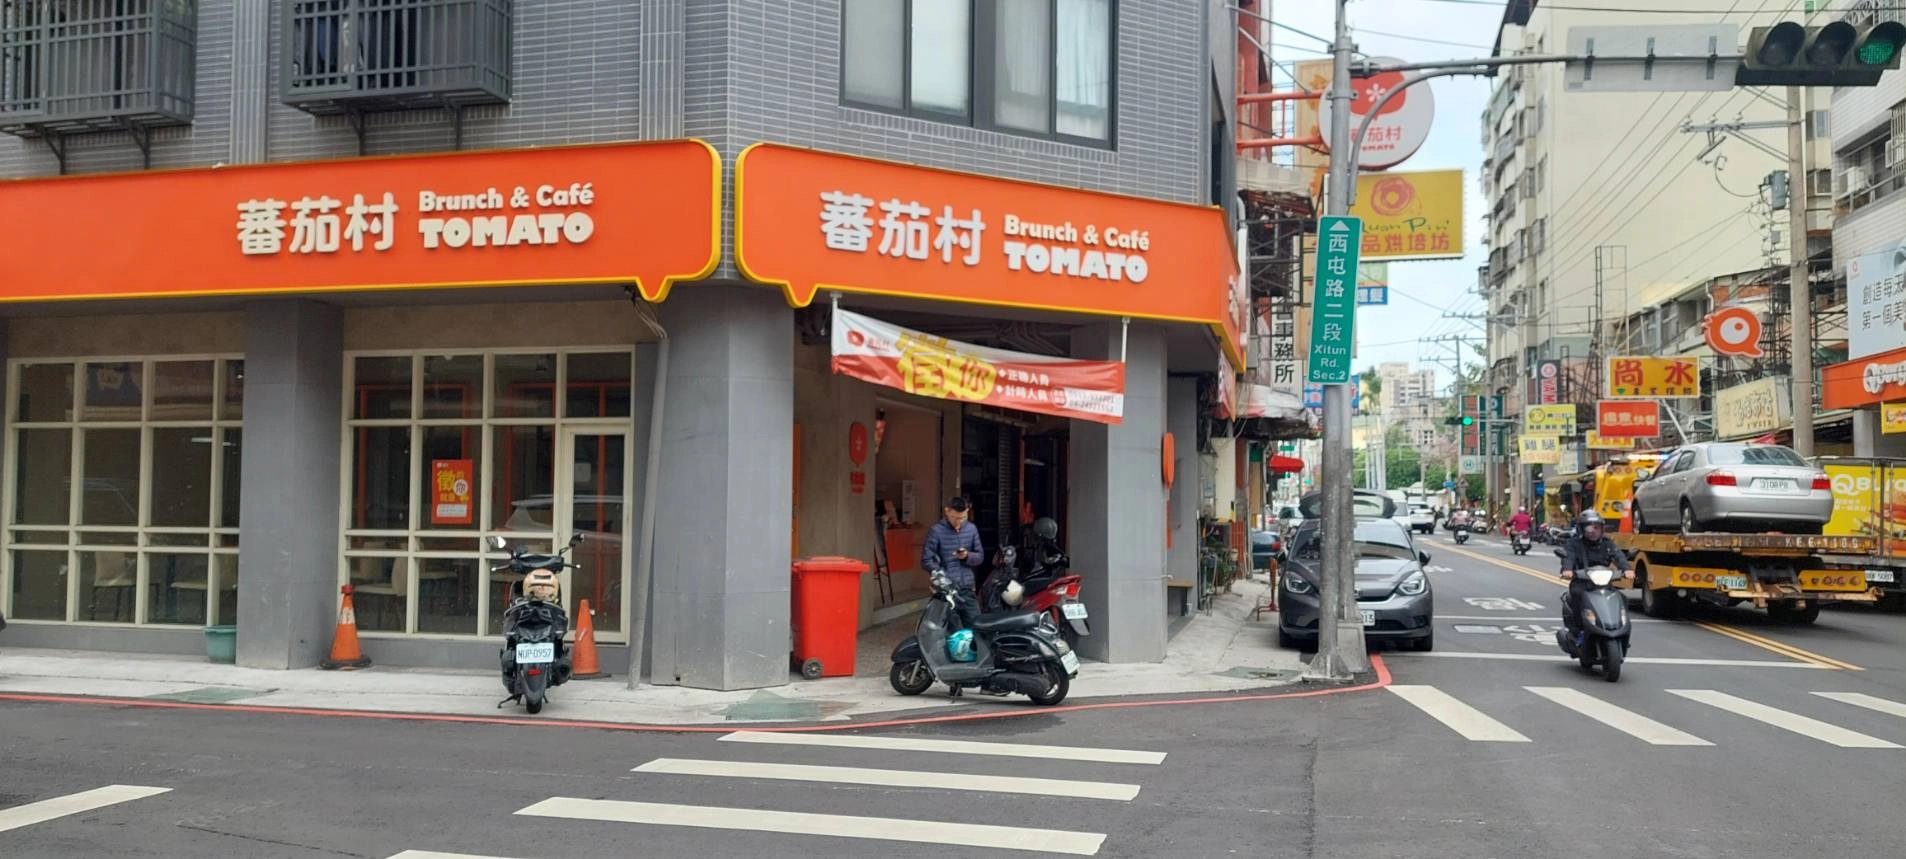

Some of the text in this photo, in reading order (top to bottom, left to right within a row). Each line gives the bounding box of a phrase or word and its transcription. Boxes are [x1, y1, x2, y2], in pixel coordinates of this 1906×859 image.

[419, 182, 595, 212] Brunch & Café
[236, 191, 400, 254] 蕃茄村
[418, 212, 594, 248] TOMATO
[820, 190, 986, 265] 蕃茄村
[1004, 213, 1150, 251] Brunch & Café
[1003, 240, 1148, 283] TOMATO
[1322, 233, 1349, 342] 西屯路二段
[1862, 273, 1904, 306] 創造每天
[1314, 344, 1347, 355] Xitun
[1320, 357, 1340, 368] Rd.
[1313, 369, 1346, 380] Sec.2
[1614, 359, 1694, 387] 尚水
